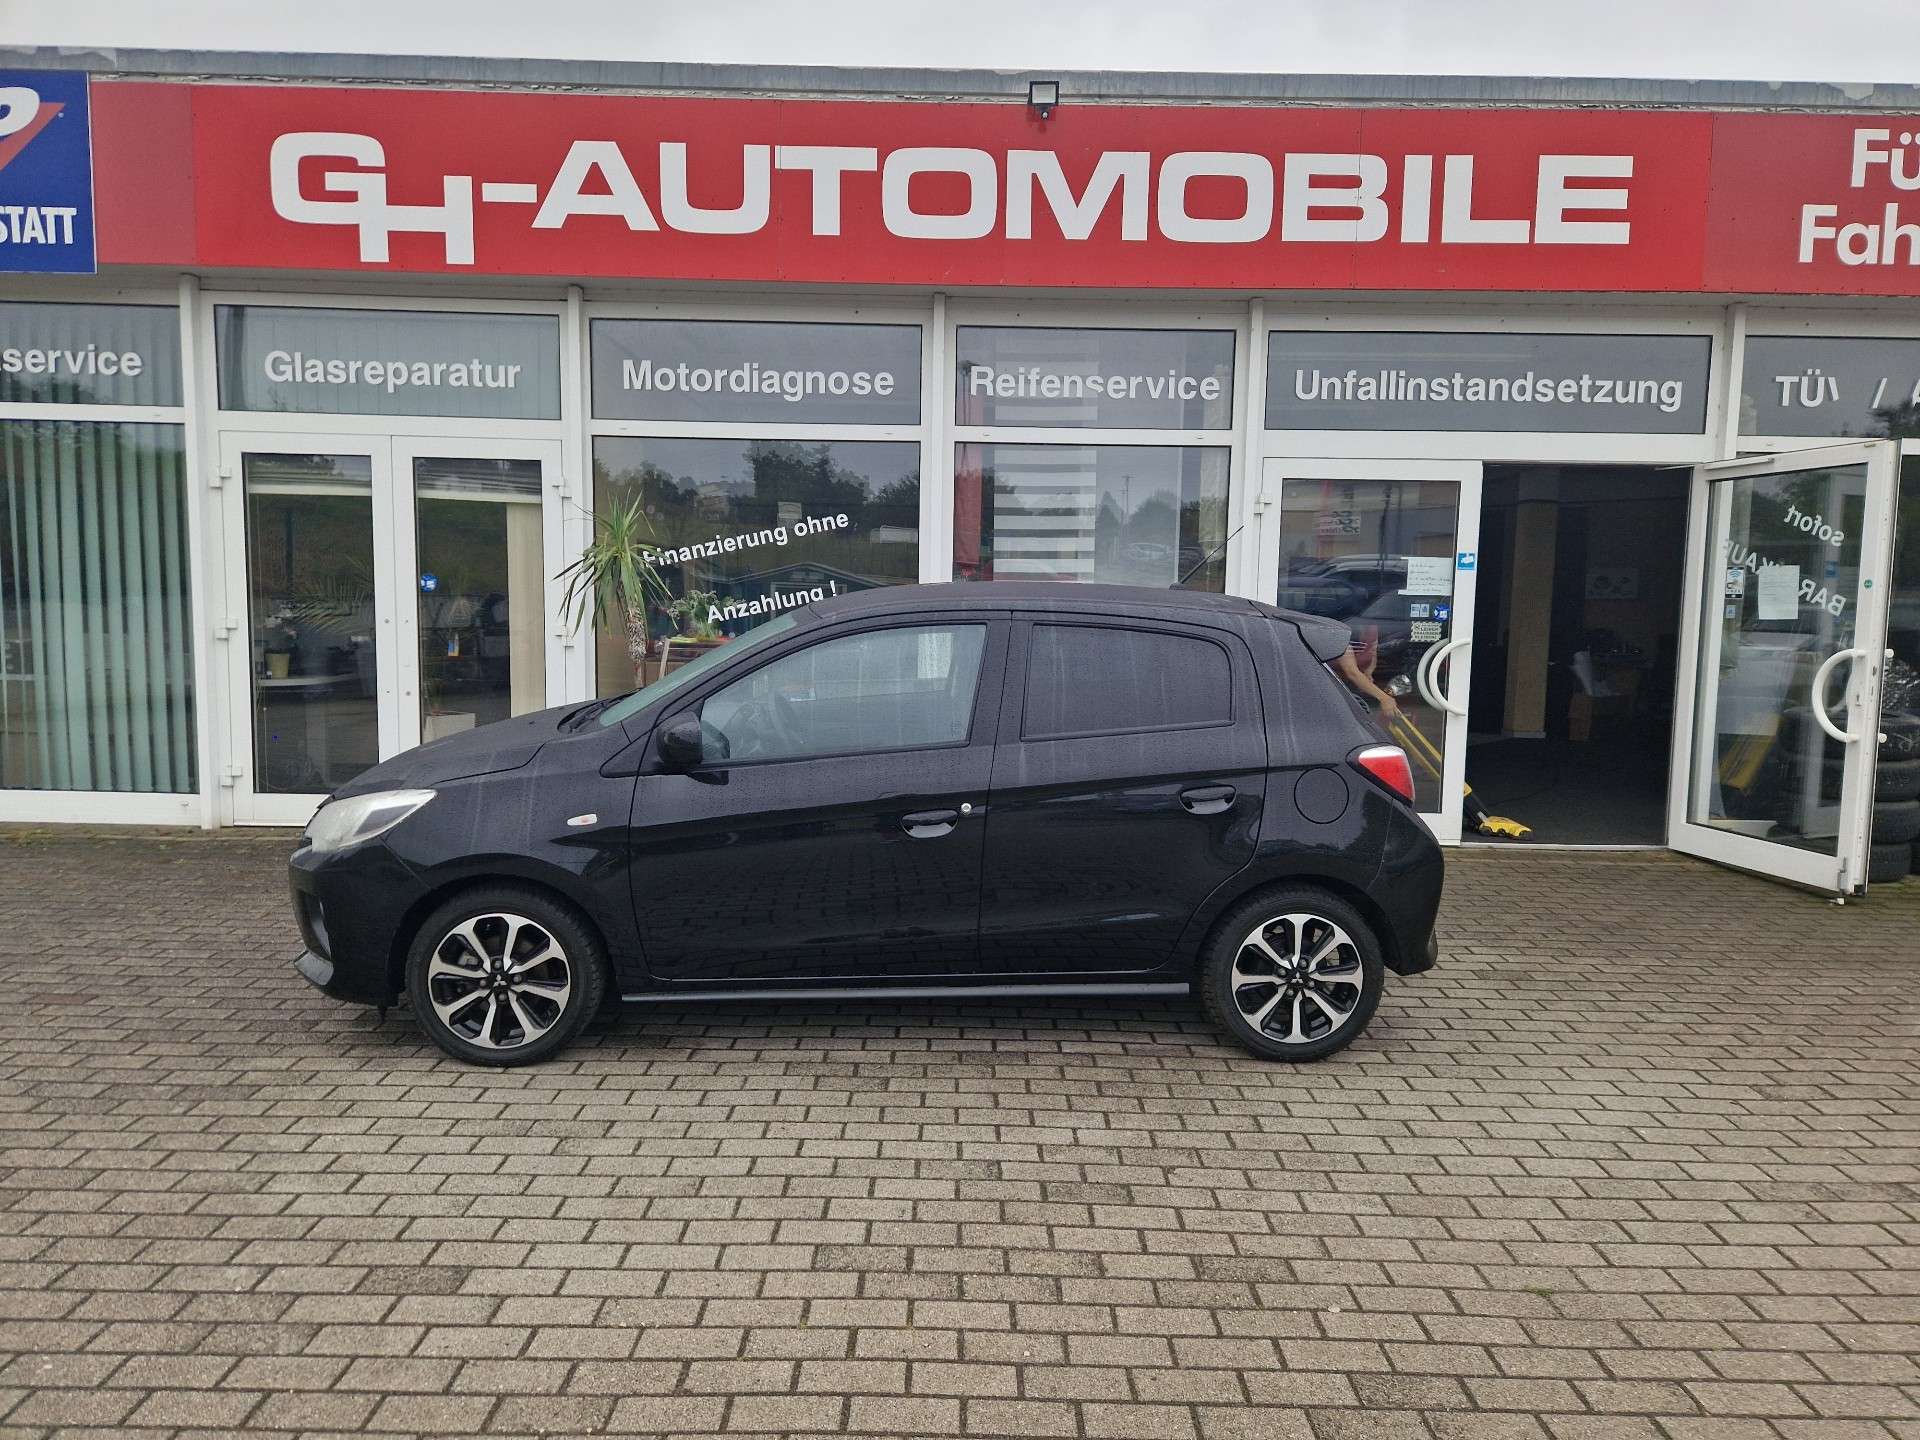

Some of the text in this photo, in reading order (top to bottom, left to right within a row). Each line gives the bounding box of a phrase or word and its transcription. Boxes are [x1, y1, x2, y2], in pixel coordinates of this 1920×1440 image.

[269, 130, 1635, 265] GH-AUTOMOBILE
[1799, 202, 1920, 266] Fah
[0, 343, 143, 377] service
[264, 348, 521, 393] Glasreparatur
[622, 358, 895, 402] Motordiagnose
[969, 365, 1221, 403] Reifenservice
[1294, 368, 1684, 413] Unfallinstandsetzung
[794, 512, 849, 537] ohne
[707, 585, 824, 624] Anzahlung
